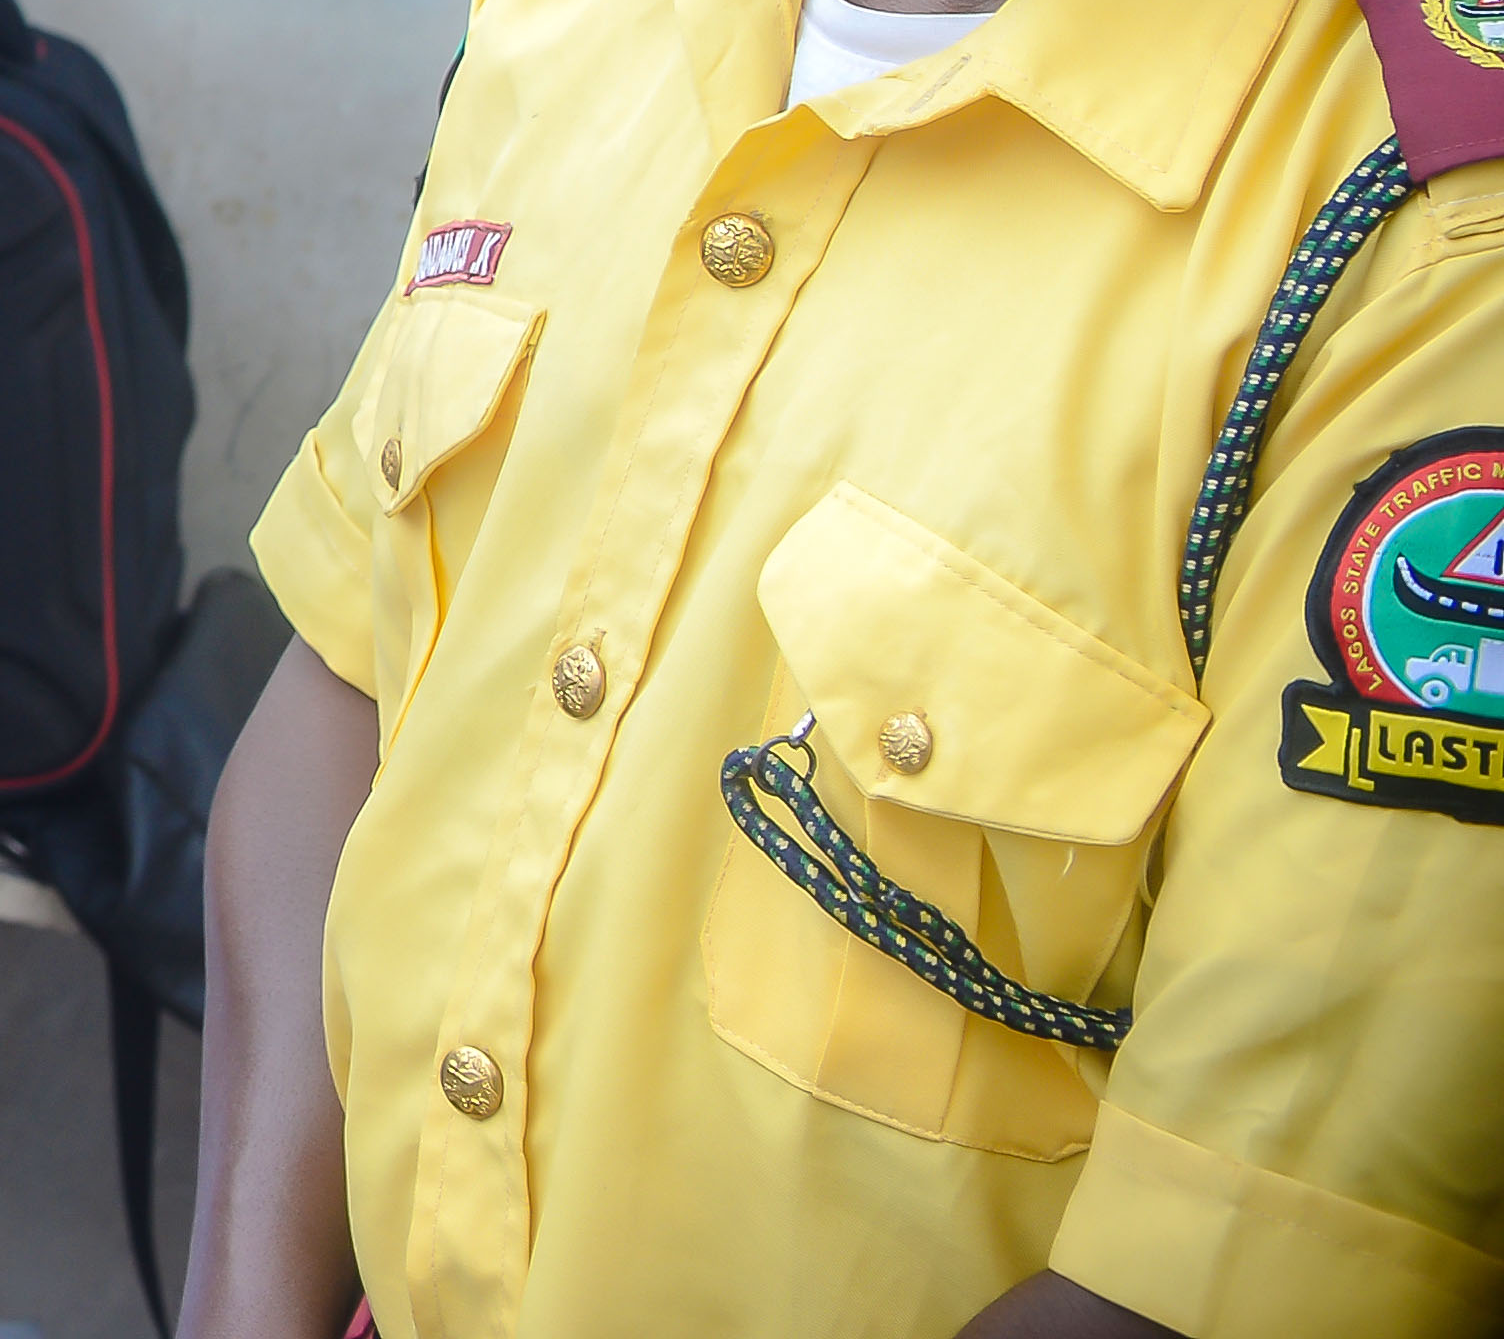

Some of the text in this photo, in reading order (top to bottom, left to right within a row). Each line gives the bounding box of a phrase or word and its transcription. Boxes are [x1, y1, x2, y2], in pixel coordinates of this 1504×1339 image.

[1340, 461, 1483, 691] LAGOS STATE TRAFFIC
[1378, 725, 1504, 779] LAST
